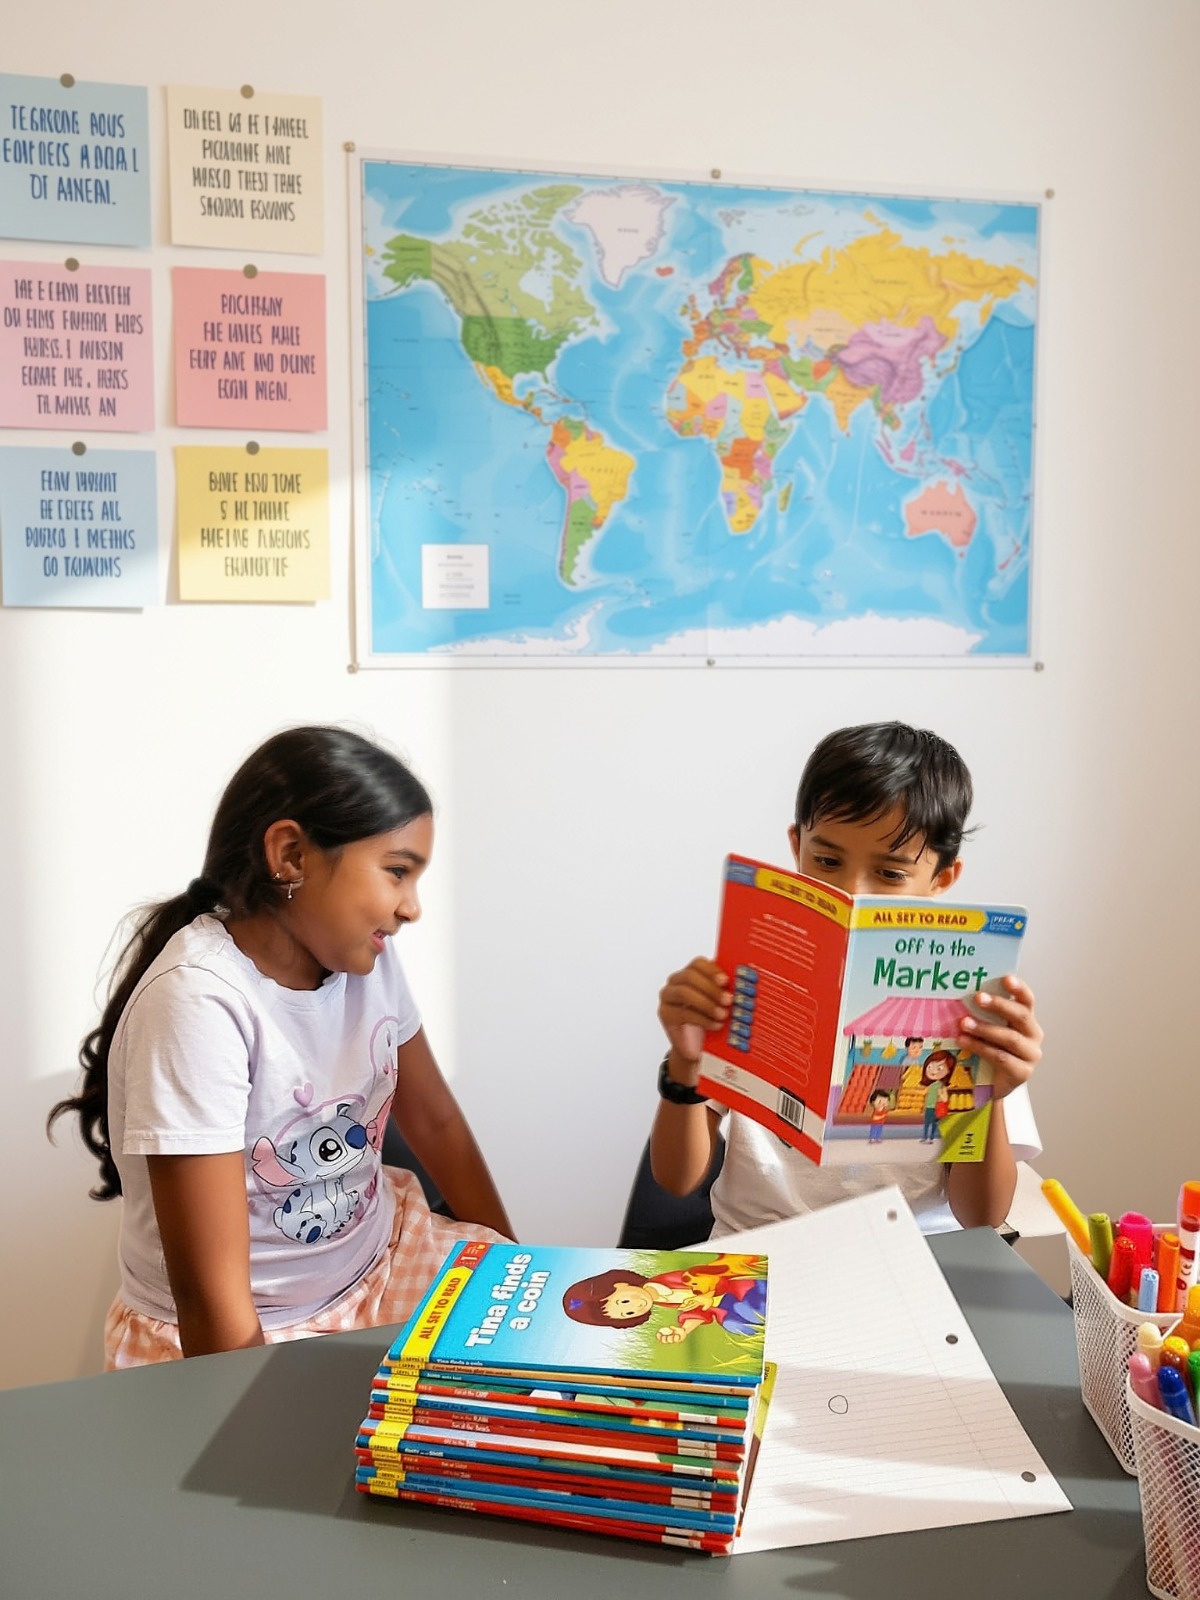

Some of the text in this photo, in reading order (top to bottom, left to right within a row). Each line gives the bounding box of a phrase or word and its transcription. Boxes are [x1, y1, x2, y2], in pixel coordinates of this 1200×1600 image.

[874, 912, 967, 925] ALL SET TO READ
[895, 937, 975, 957] Off to the
[873, 957, 988, 992] Market
[419, 1277, 461, 1340] ALL SET TO READ
[464, 1304, 509, 1347] Tina
[491, 1253, 533, 1301] finds
[510, 1271, 551, 1330] a coin
